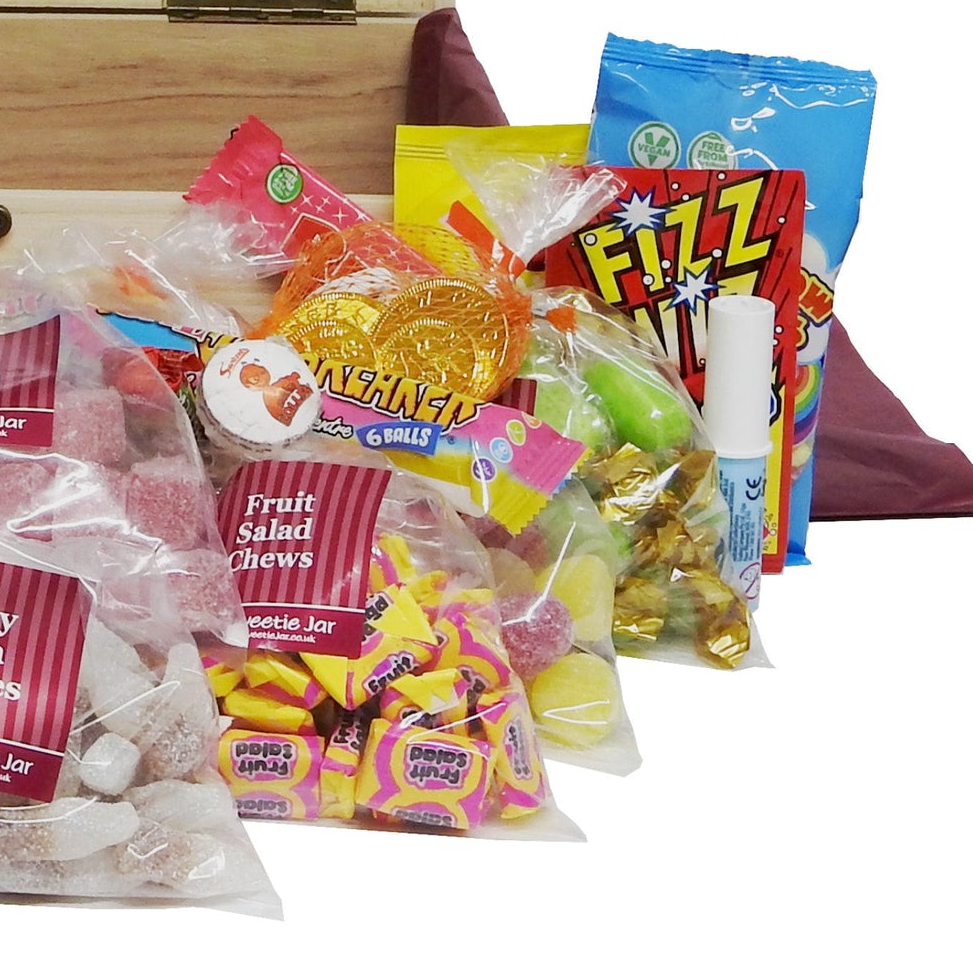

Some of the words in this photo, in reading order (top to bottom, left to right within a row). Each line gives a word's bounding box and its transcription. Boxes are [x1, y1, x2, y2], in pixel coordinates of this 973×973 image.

[638, 143, 671, 158] VEGAN
[698, 150, 727, 162] FROM
[701, 140, 726, 153] FREE
[579, 177, 773, 305] FIZZ
[315, 417, 353, 437] entre
[365, 427, 382, 447] 6
[383, 426, 433, 447] BALLS
[244, 491, 316, 517] Fruit
[235, 518, 313, 545] Salad
[228, 547, 314, 572] Chews
[246, 614, 301, 631] eetie
[303, 615, 337, 635] Jar
[1, 753, 34, 776] Jar
